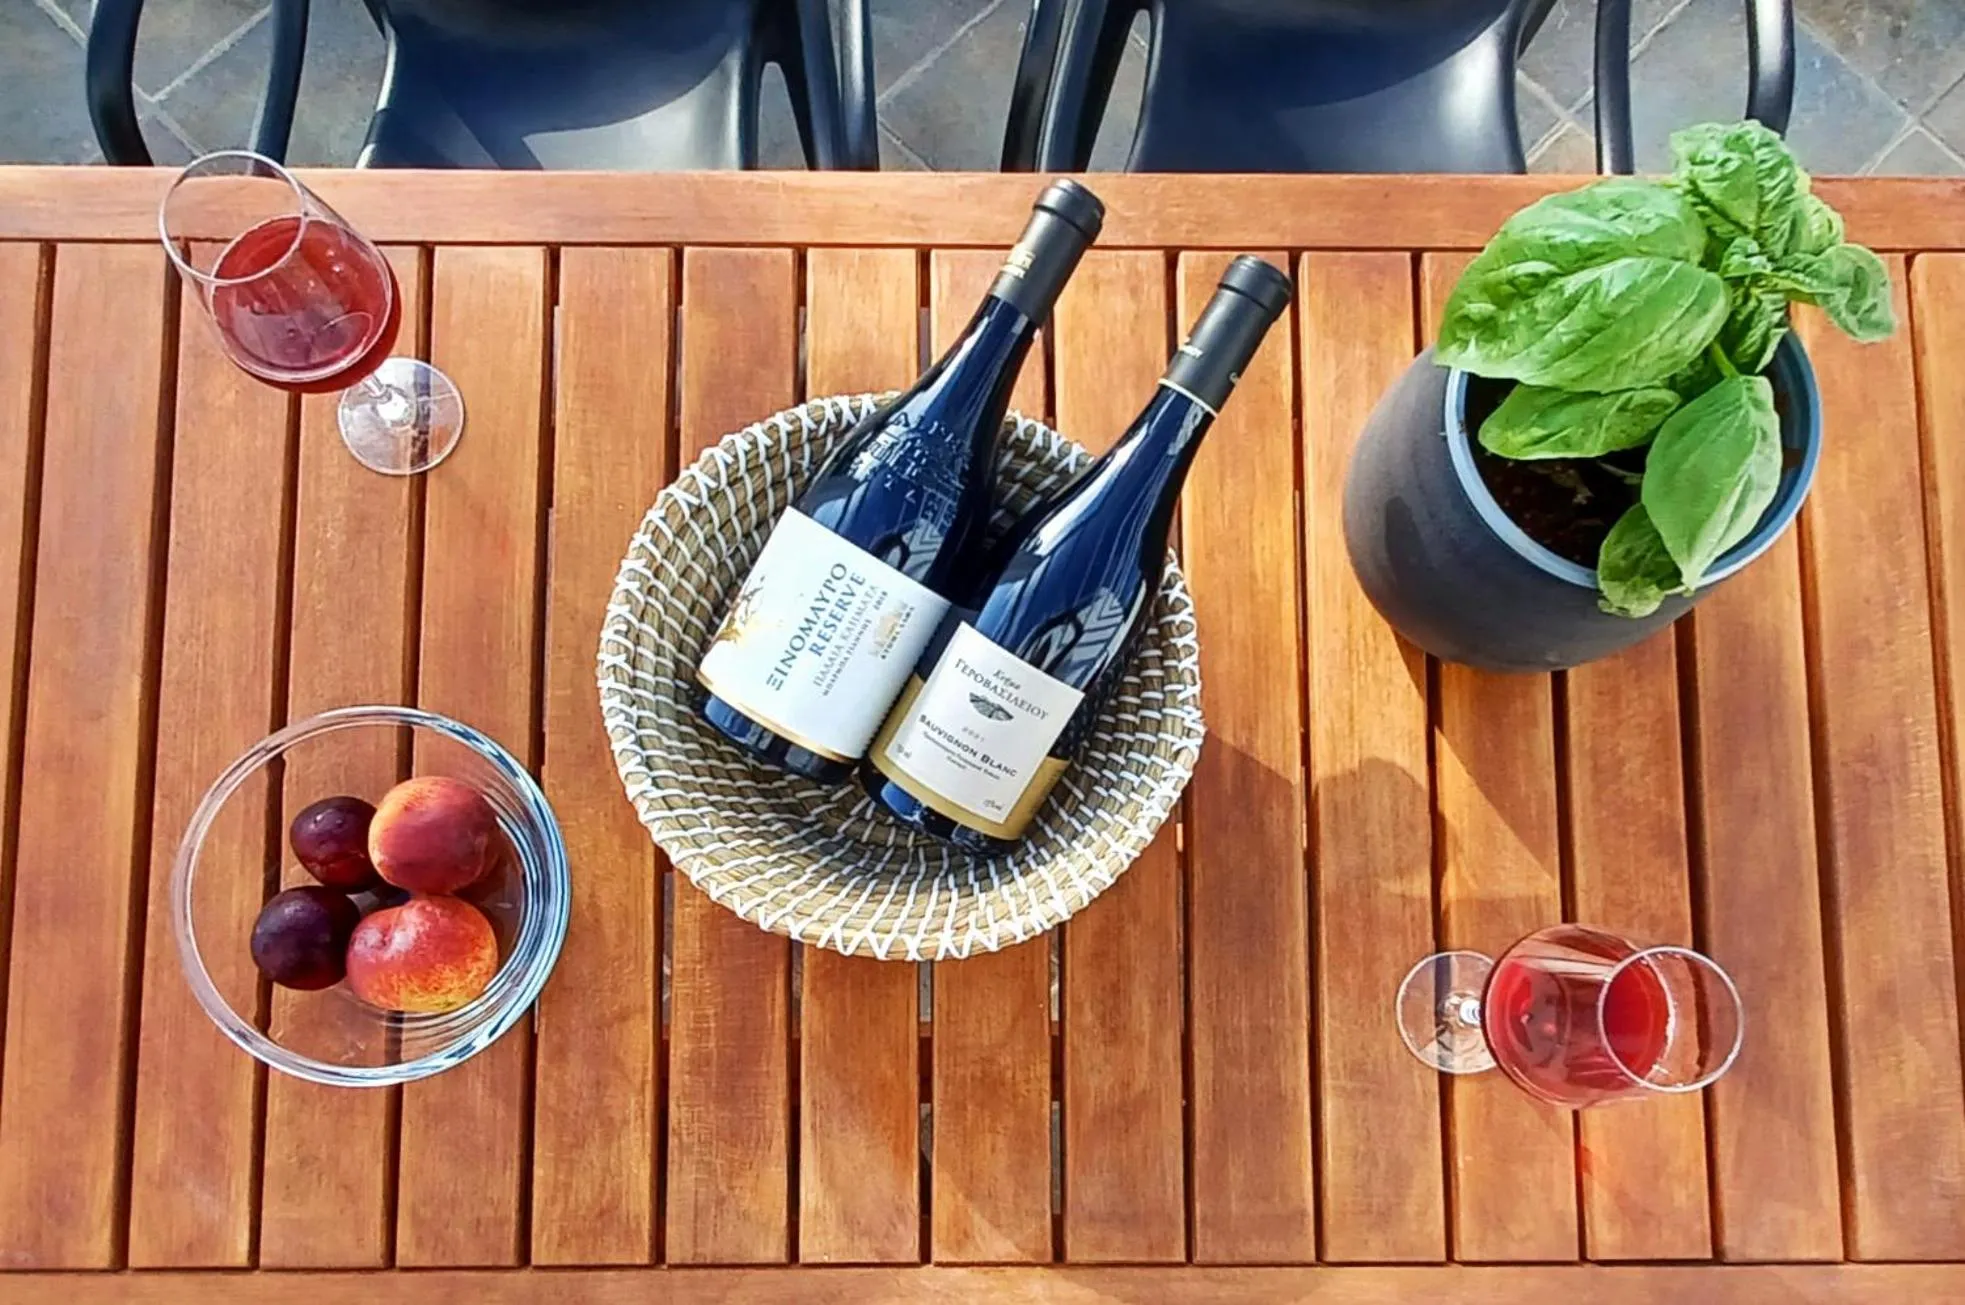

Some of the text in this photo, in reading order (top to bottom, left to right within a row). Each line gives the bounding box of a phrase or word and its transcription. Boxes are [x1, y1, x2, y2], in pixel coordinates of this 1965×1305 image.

[766, 562, 847, 691] ΞΙΝΟΜΑΥΡΟ
[807, 573, 866, 657] RESERVE
[954, 658, 1049, 721] ΓΕΡΟΒΑΣΙΛΕΙΟΥ
